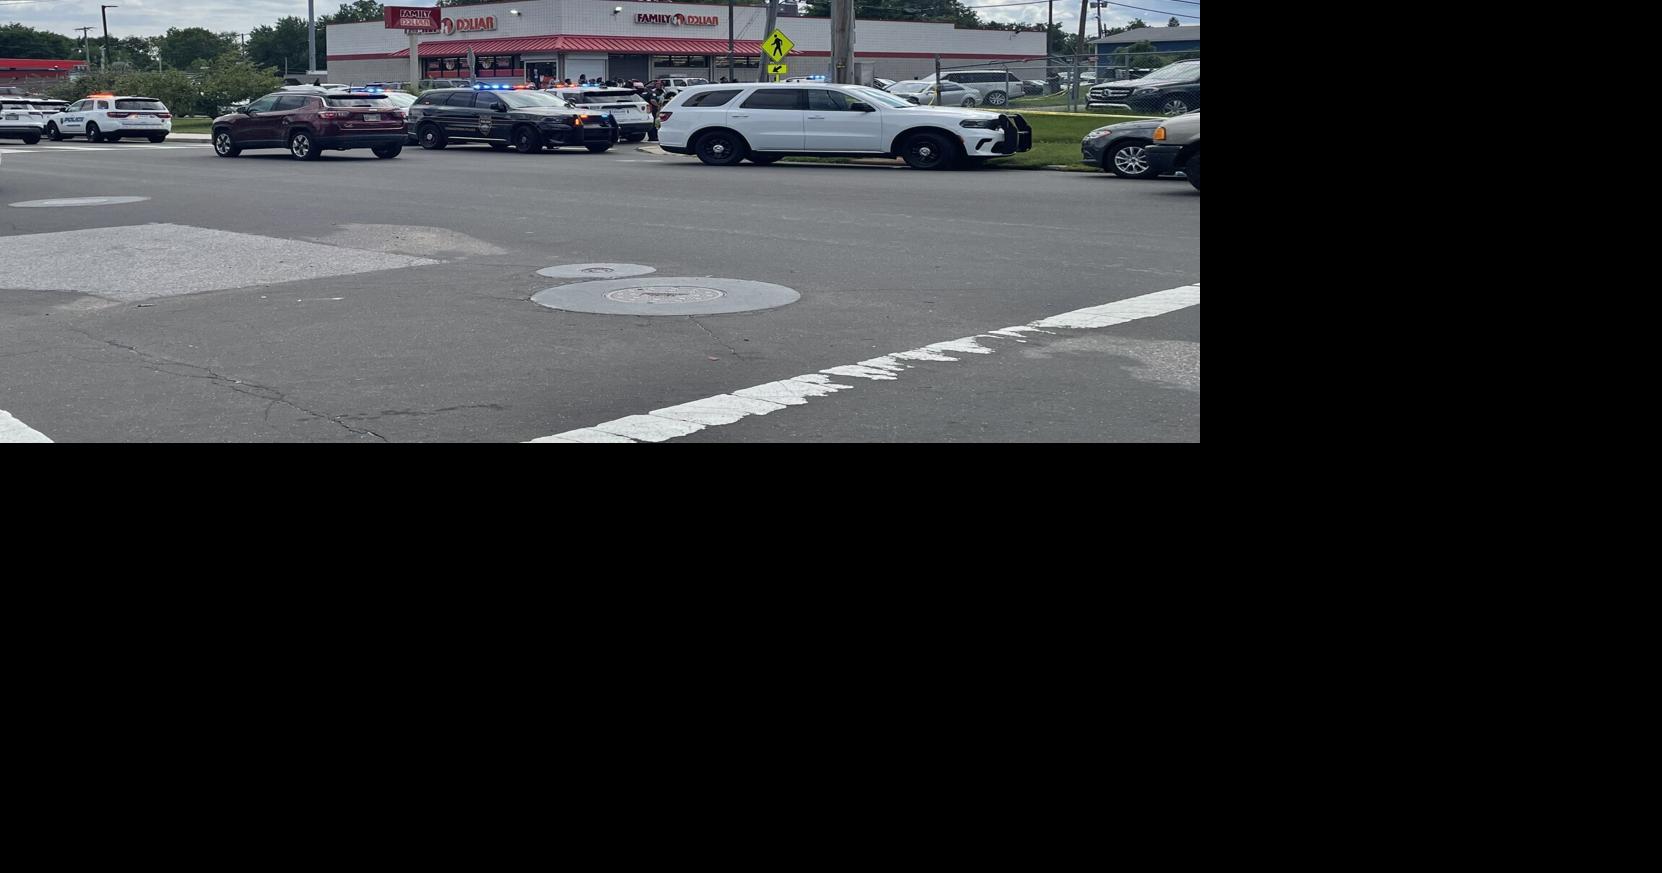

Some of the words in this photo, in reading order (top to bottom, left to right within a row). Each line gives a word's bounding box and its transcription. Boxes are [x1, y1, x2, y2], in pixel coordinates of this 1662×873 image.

[400, 9, 432, 18] FAMILY
[637, 13, 672, 24] FAMILY
[687, 15, 719, 26] DOLLAR
[456, 16, 495, 31] DOLLAR
